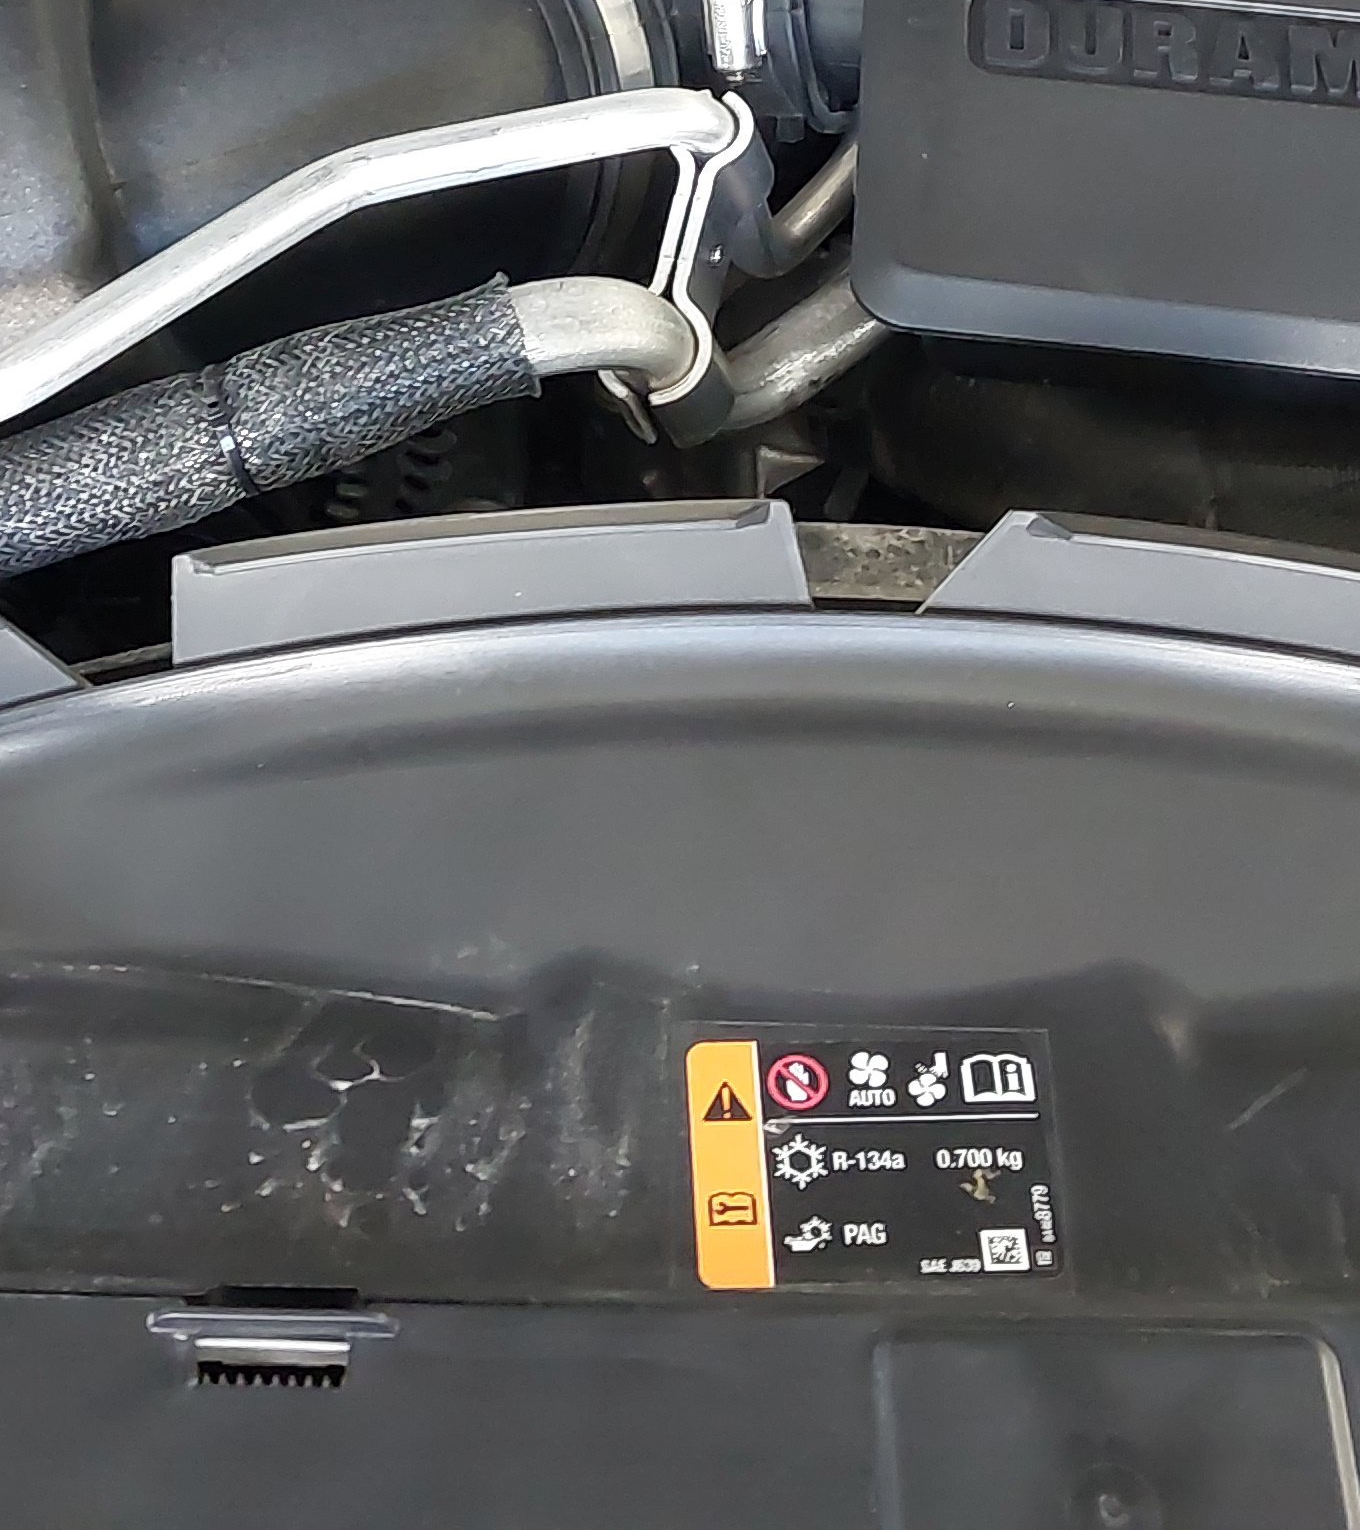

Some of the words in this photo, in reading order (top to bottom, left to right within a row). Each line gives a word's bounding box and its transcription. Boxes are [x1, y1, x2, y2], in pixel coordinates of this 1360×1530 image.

[848, 1088, 897, 1108] AUTO
[832, 1151, 907, 1171] R-134a
[936, 1149, 994, 1169] 0.700
[996, 1149, 1024, 1172] kg
[843, 1223, 888, 1246] PAG
